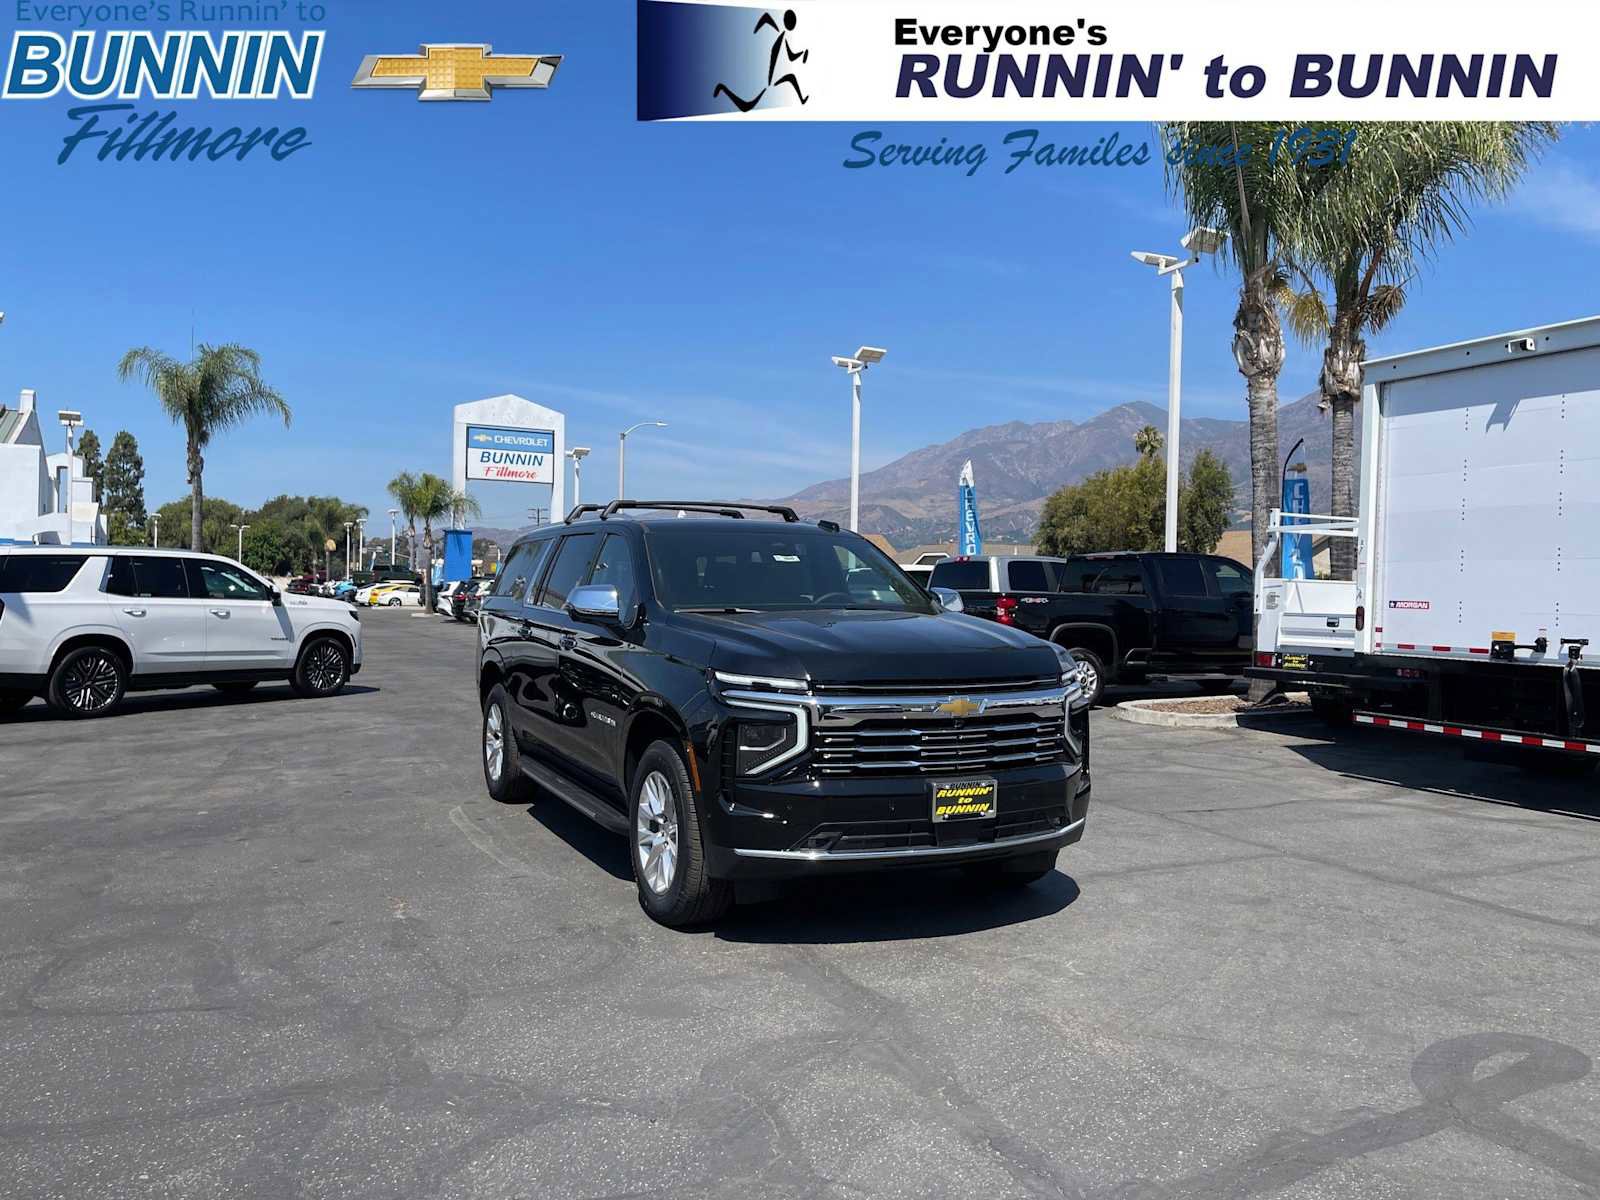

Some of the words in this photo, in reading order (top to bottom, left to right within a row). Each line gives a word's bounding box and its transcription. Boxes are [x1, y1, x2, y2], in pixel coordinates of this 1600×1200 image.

[494, 434, 548, 447] CHEVROLET
[480, 451, 544, 466] BUNNIN
[484, 465, 538, 479] Fillmore
[936, 786, 994, 798] RUNNIN'
[957, 796, 973, 804] to
[935, 803, 990, 816] BUNNIN
